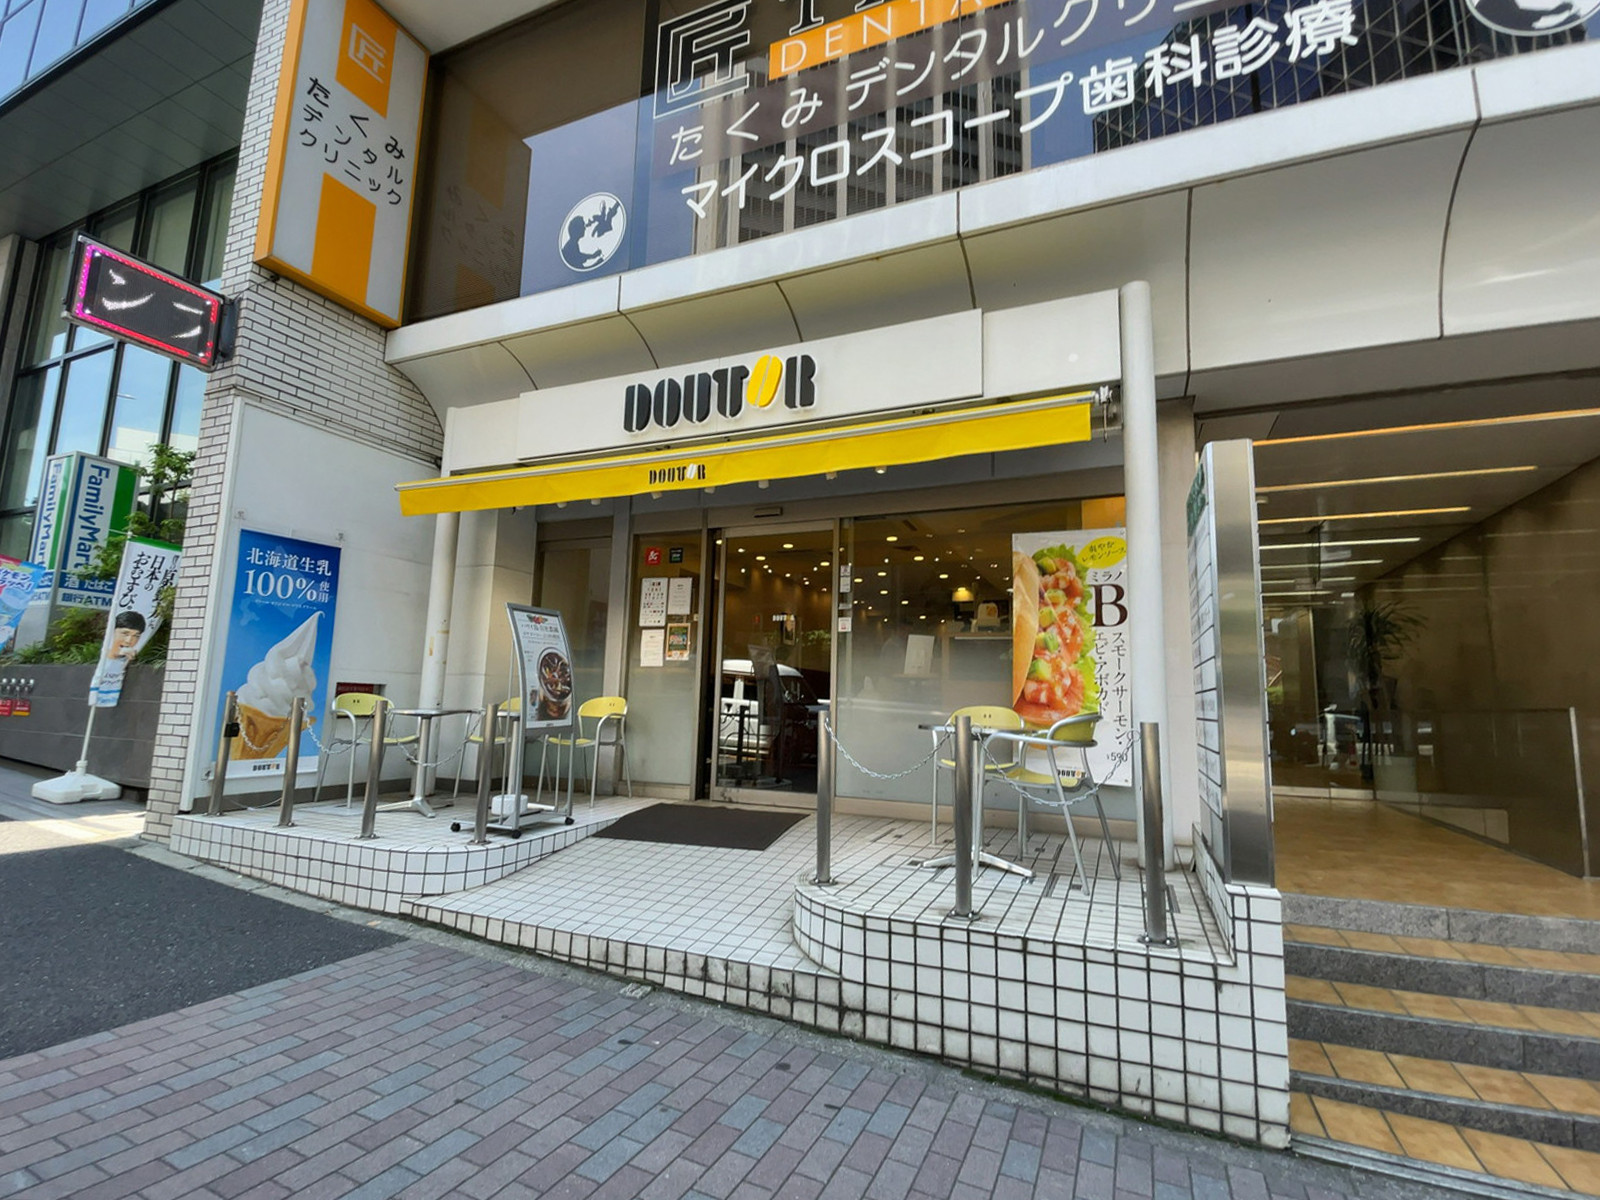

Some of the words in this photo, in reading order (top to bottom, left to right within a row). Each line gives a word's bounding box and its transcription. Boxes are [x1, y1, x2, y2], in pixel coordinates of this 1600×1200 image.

[309, 77, 405, 159] たくみ
[681, 0, 1358, 218] マイクロスコープ歯科診療
[303, 104, 403, 184] デンタル
[300, 129, 402, 205] クリニック
[624, 355, 816, 432] DOUTOR
[649, 463, 706, 485] DOUTOR
[0, 568, 31, 581] ケモン
[118, 551, 151, 610] おむすび。
[144, 555, 165, 592] 日本の
[246, 547, 332, 576] 北海道生乳
[1092, 570, 1123, 583] ミラノ
[243, 569, 317, 602] 100%
[319, 581, 331, 603] 使用
[1088, 583, 1128, 628] B
